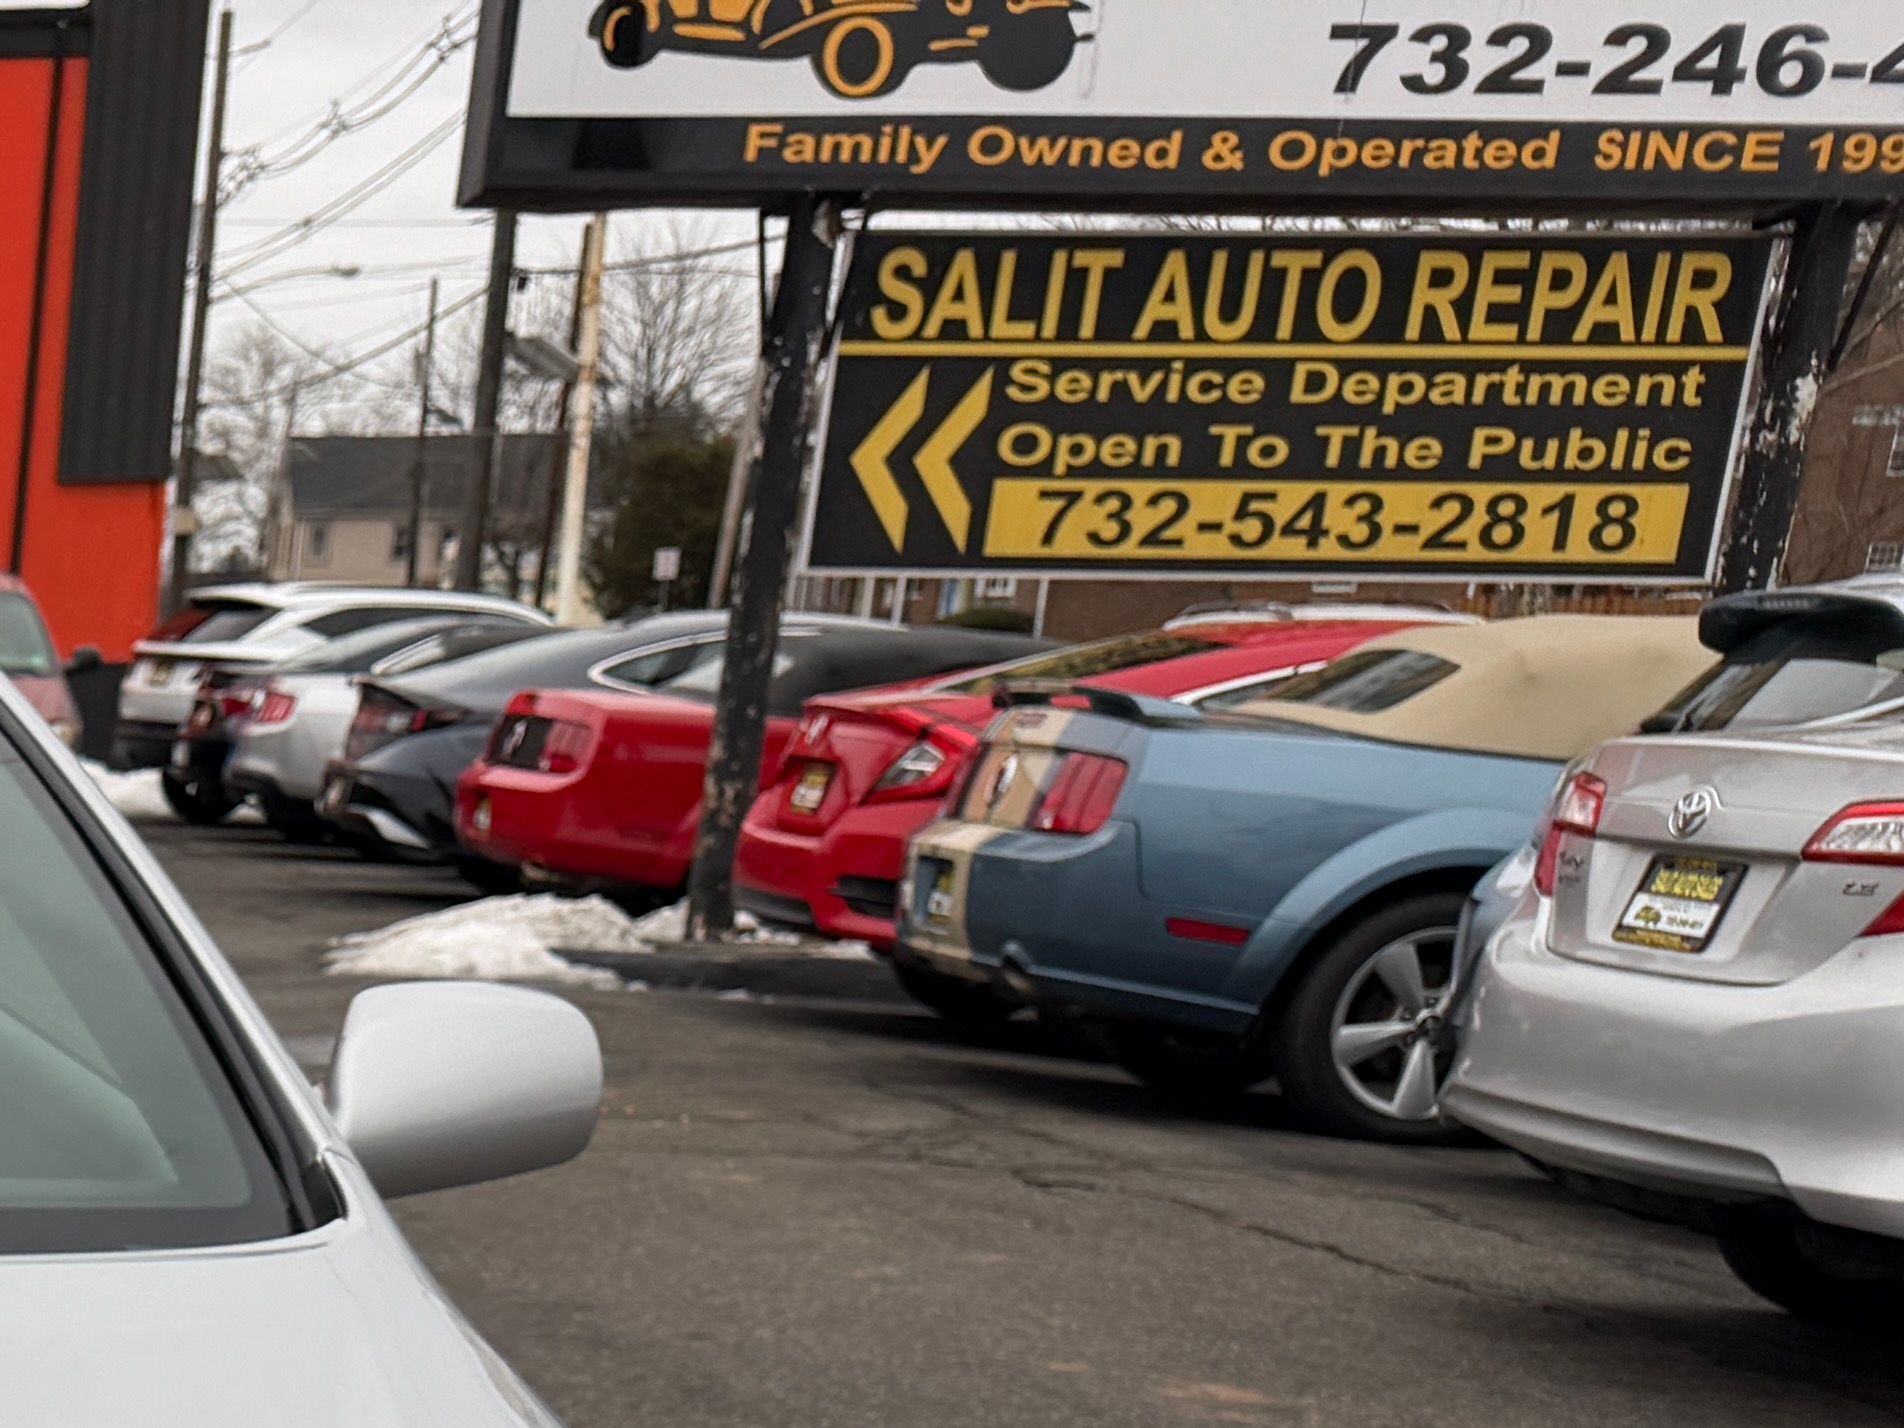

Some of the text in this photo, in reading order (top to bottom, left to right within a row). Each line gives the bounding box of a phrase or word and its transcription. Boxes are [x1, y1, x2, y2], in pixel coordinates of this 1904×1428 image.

[743, 123, 949, 175] Family
[967, 126, 1184, 170] Owned
[1200, 130, 1245, 171] &
[1268, 129, 1562, 177] Operated
[1593, 129, 1786, 173] SINCE
[869, 246, 1734, 344] SALIT AUTO REPAIR
[1004, 358, 1707, 416] Service Department
[996, 421, 1693, 478] Open To The Public
[1036, 488, 1640, 554] 732-543-2818
